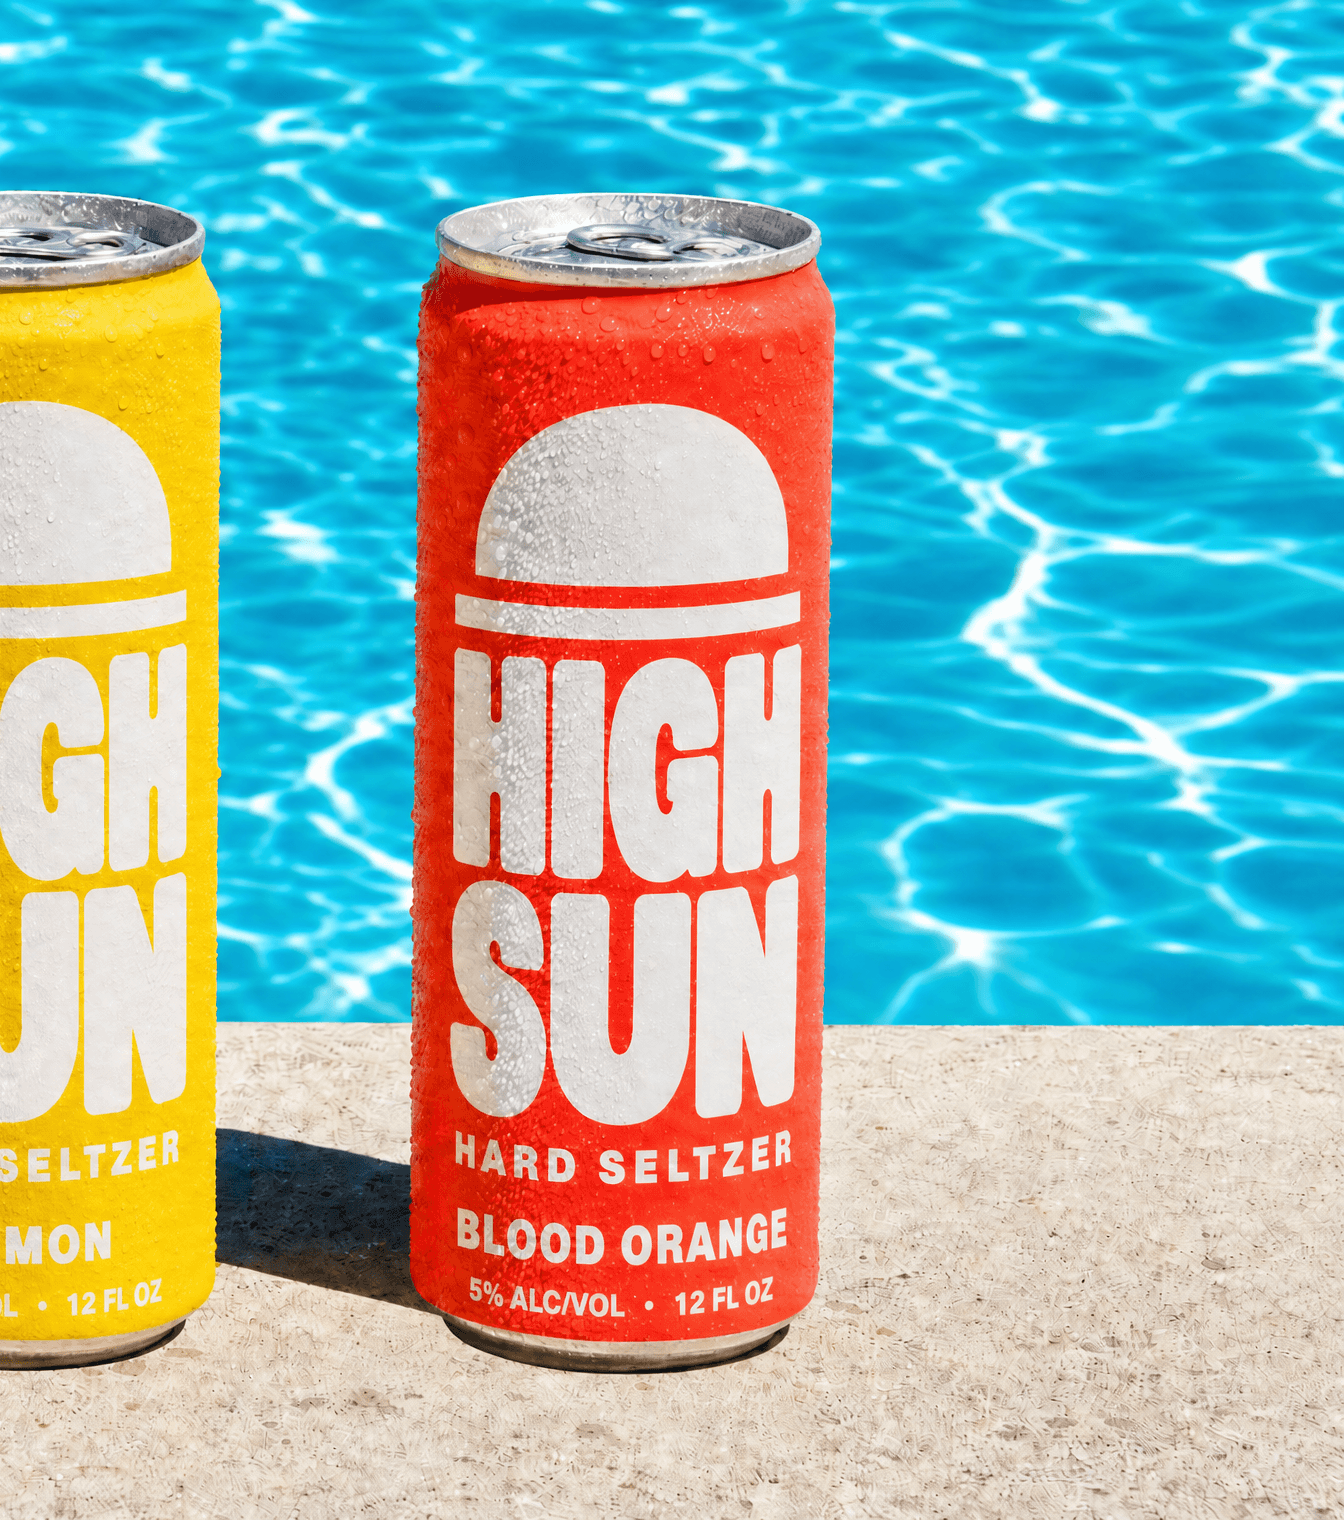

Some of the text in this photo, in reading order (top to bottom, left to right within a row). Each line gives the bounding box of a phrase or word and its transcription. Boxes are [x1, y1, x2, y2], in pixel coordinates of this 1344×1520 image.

[453, 643, 802, 883] HIGH
[449, 873, 799, 1126] SUN
[455, 1129, 792, 1185] HARD SELTZER
[456, 1207, 787, 1266] BLOOD ORANGE
[67, 1291, 96, 1317] 12
[104, 1286, 129, 1313] FL
[133, 1277, 162, 1306] OZ
[468, 1275, 774, 1318] 5% ALC/VOL 12 FL OZ
